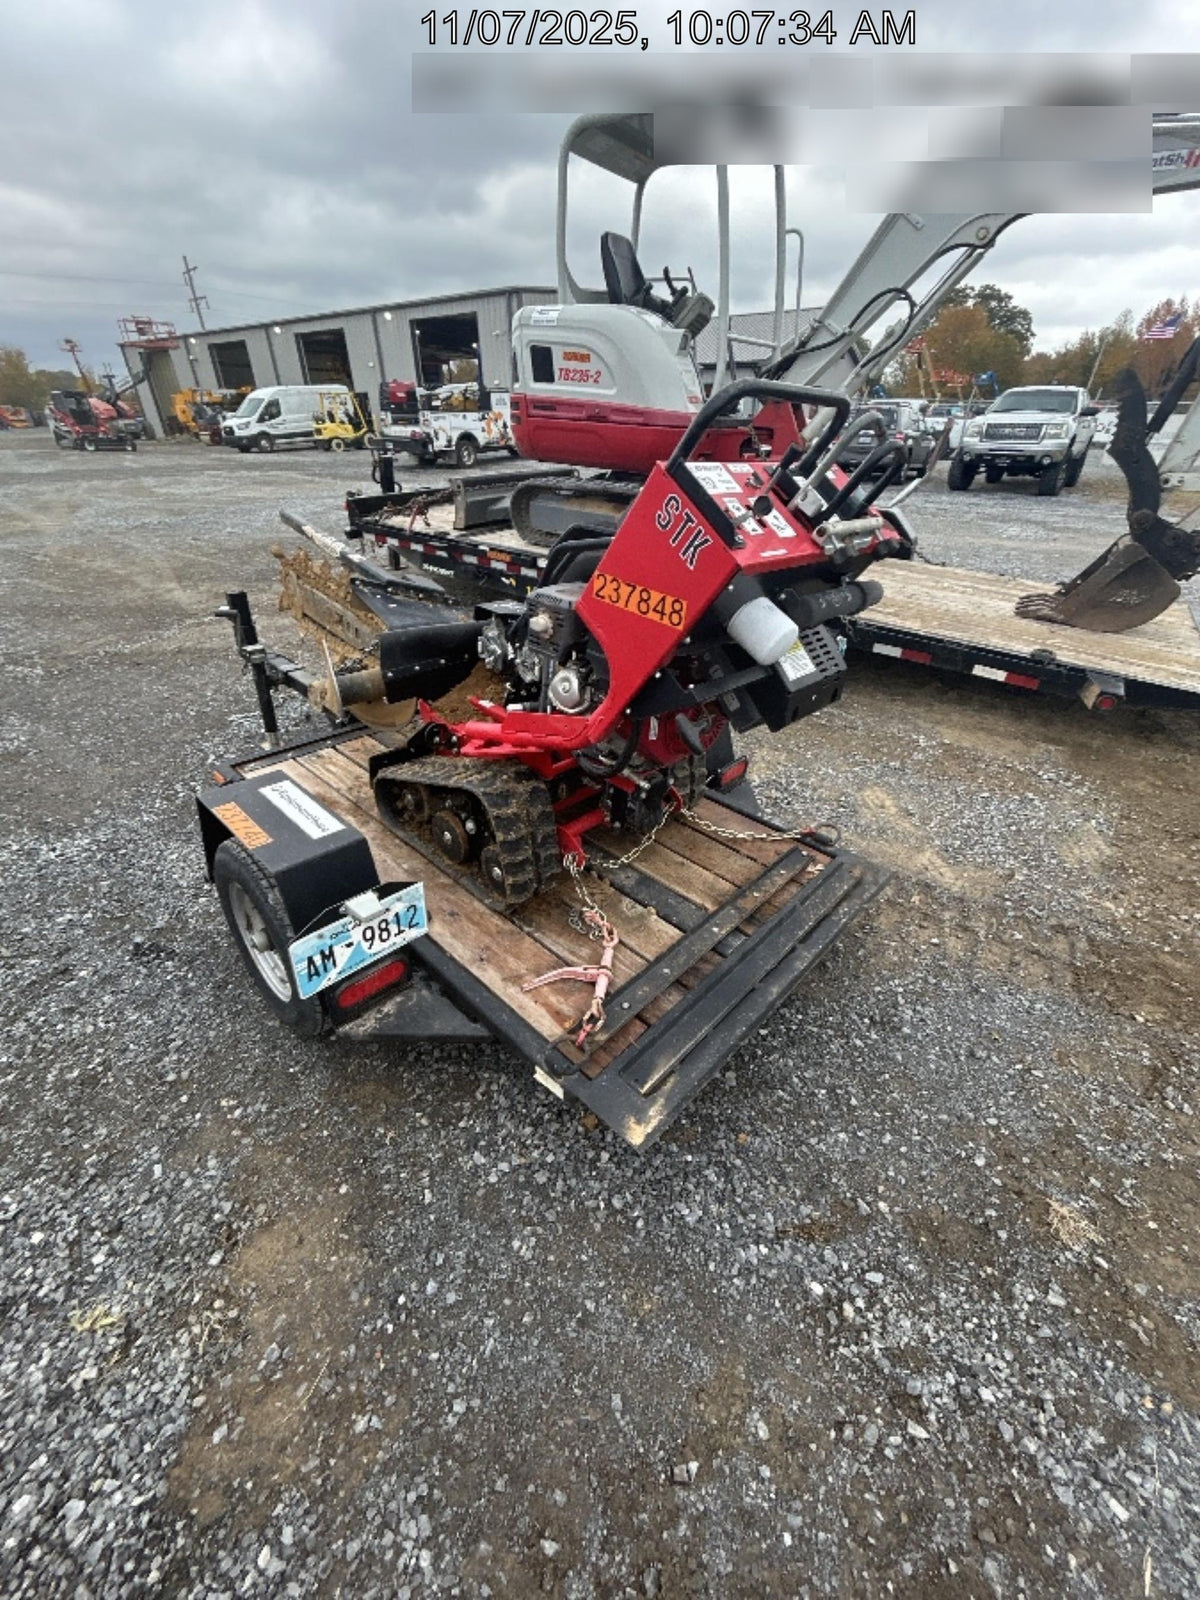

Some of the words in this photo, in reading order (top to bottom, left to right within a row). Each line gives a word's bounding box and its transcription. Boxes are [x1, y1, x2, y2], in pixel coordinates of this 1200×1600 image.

[557, 367, 602, 384] TB235-2
[655, 493, 714, 571] STK
[594, 573, 685, 627] 237848
[306, 944, 338, 982] AM
[362, 904, 420, 950] 9812
